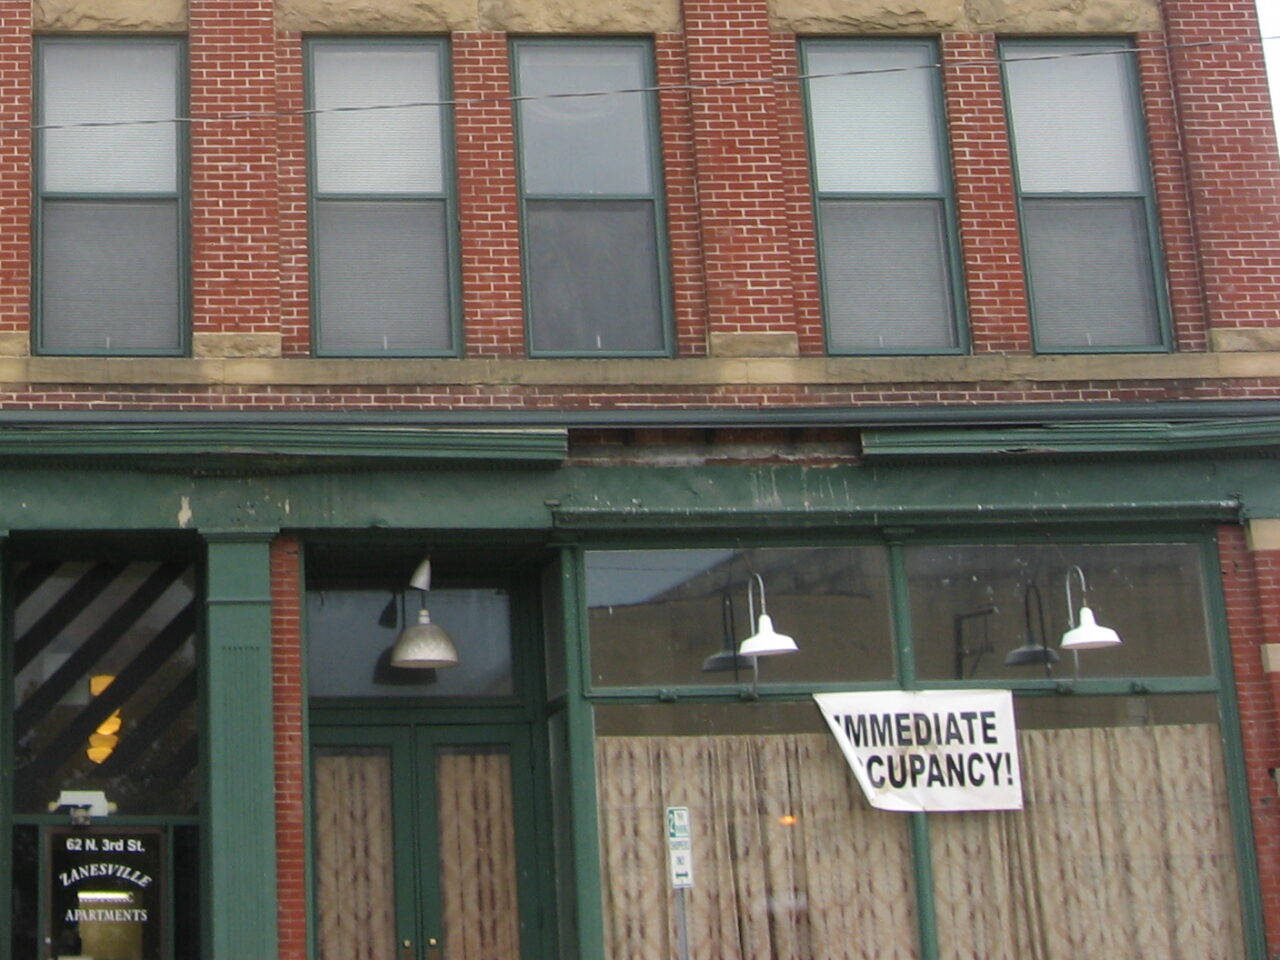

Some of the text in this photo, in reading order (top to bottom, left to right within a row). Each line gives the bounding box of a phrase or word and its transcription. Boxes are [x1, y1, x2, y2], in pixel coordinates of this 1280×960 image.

[858, 752, 1014, 789] CUPANCY!
[66, 838, 146, 852] 62 N. 3rd St.
[59, 863, 153, 887] ZANESVILLE
[65, 908, 148, 922] APARTMENTS
